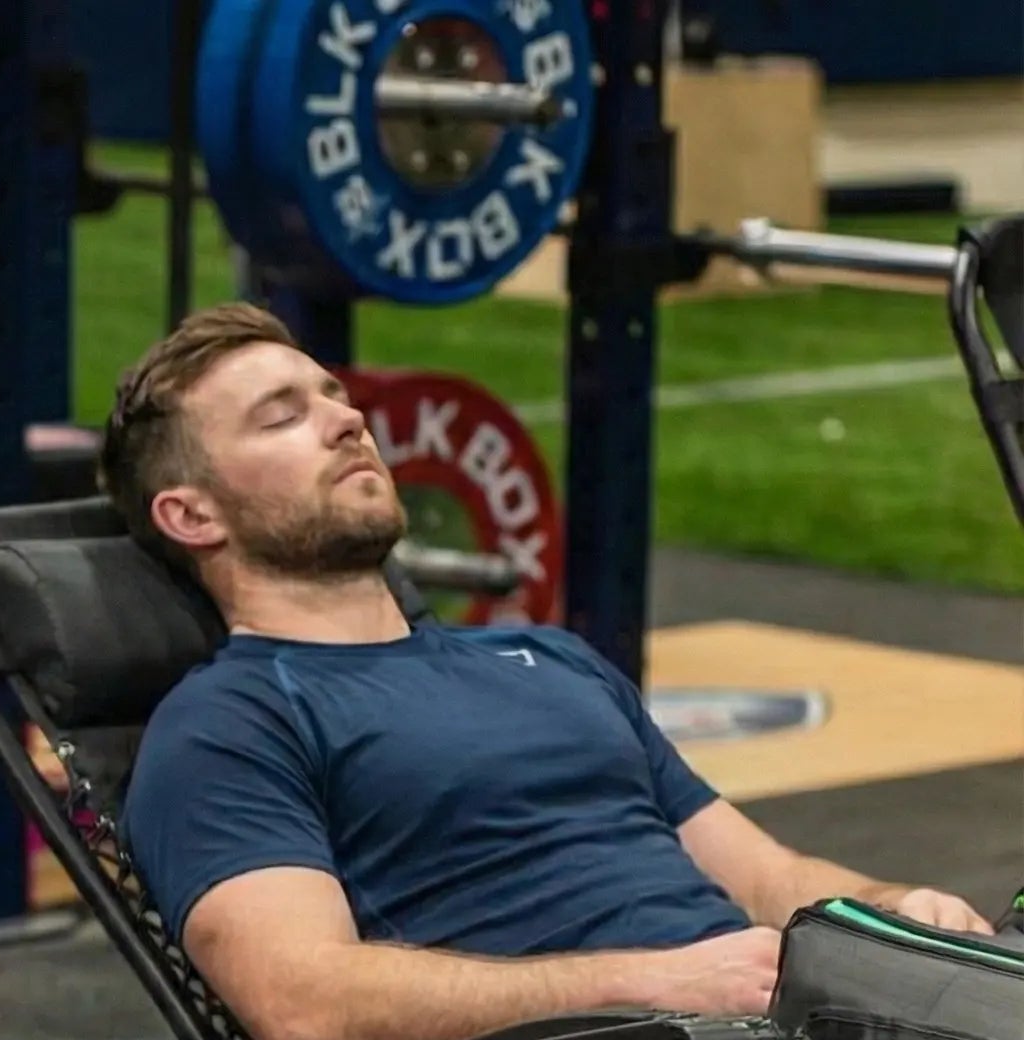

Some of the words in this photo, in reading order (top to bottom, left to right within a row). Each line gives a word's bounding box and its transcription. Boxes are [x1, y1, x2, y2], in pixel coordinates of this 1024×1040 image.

[306, 3, 376, 178] BLK
[506, 32, 576, 200] BK
[377, 190, 521, 281] BOX
[371, 398, 460, 467] LK
[460, 421, 548, 583] BOX
